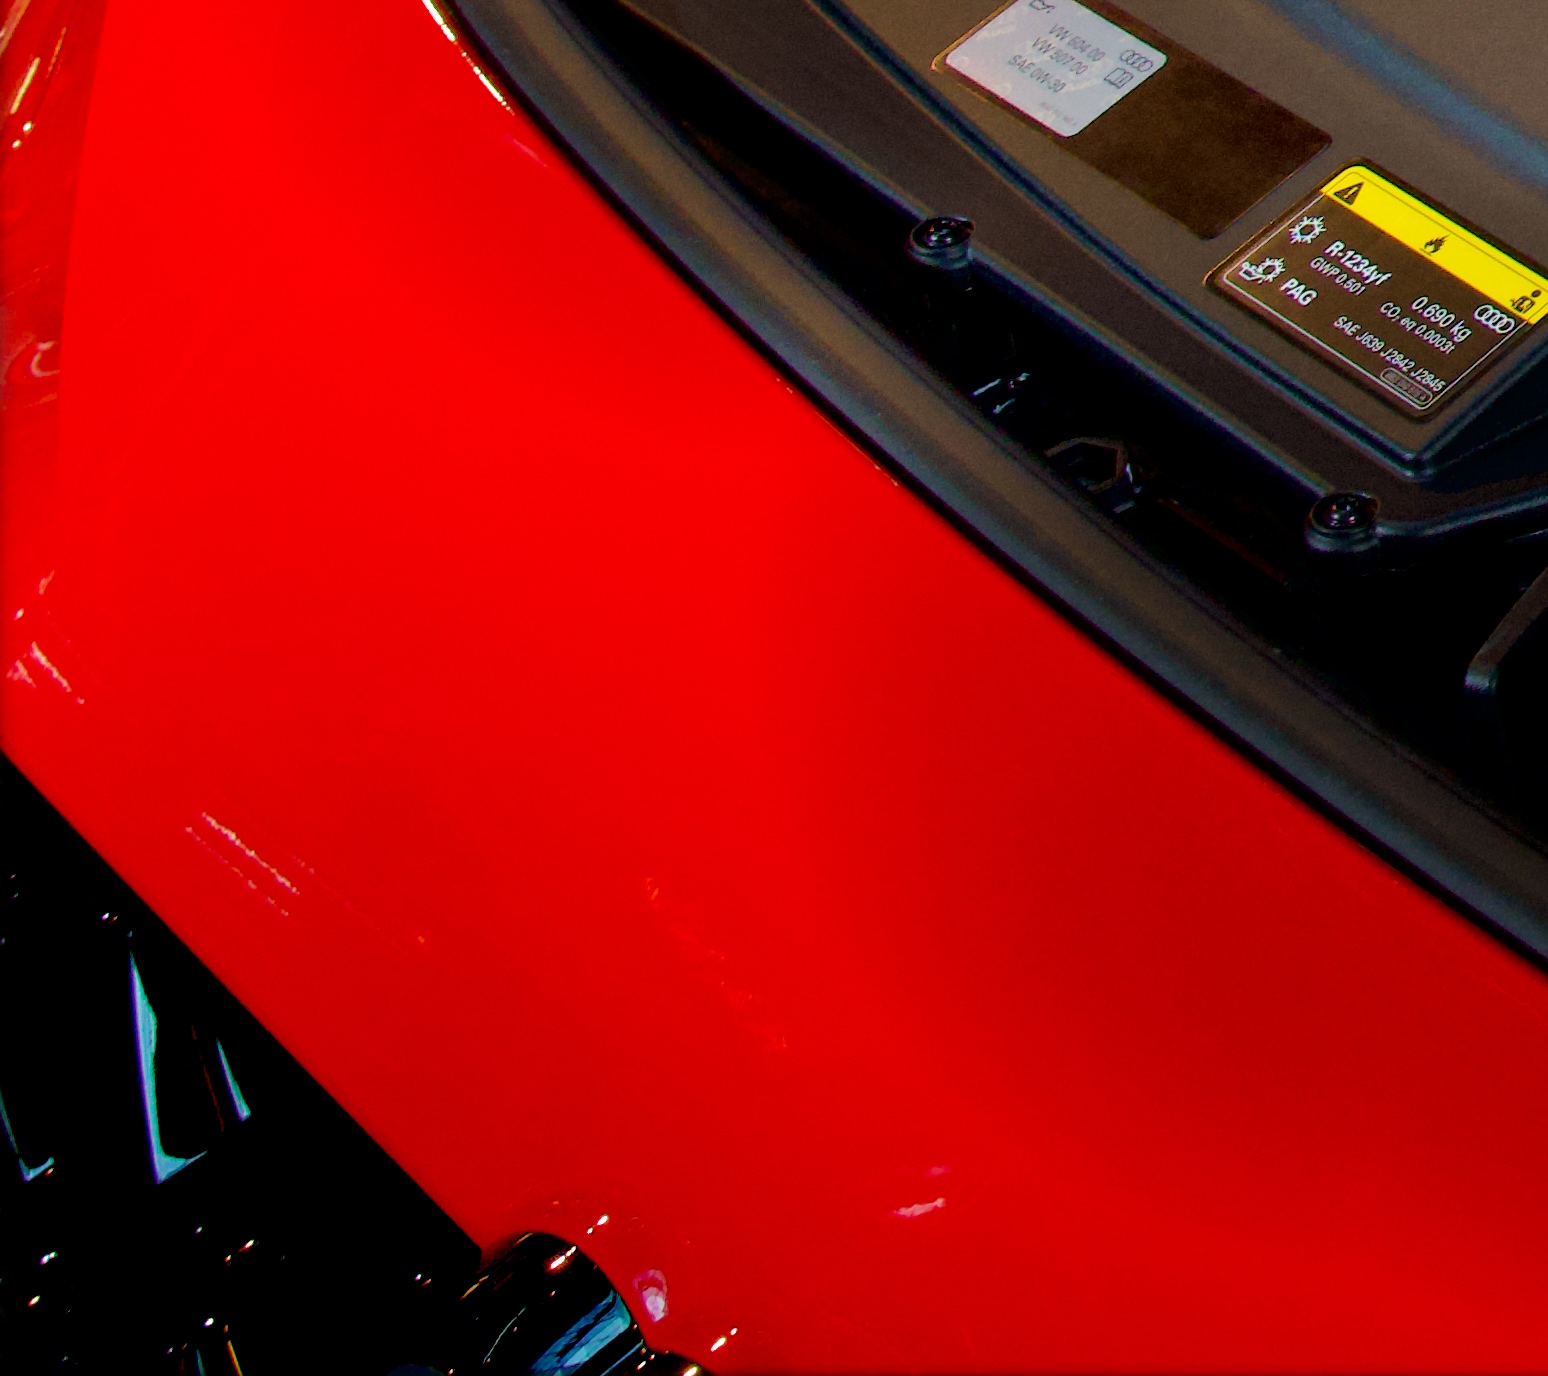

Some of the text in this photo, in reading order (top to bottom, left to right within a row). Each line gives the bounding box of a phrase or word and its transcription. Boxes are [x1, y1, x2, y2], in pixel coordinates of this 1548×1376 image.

[1008, 54, 1067, 94] SAE 0W-30
[1031, 36, 1089, 76] VW 507 00
[1049, 23, 1106, 63] VW 504 00
[1309, 256, 1341, 280] GWP
[1334, 272, 1366, 298] 0.501
[1398, 314, 1420, 334] eq
[1413, 323, 1457, 356] 0.0003t
[1323, 239, 1473, 344] R-1234yf 0.690 kg
[1279, 277, 1319, 307] PAG
[1332, 315, 1362, 338] SAE
[1354, 329, 1386, 353] J639
[1380, 348, 1416, 373] J2842
[1409, 367, 1447, 392] J2845
